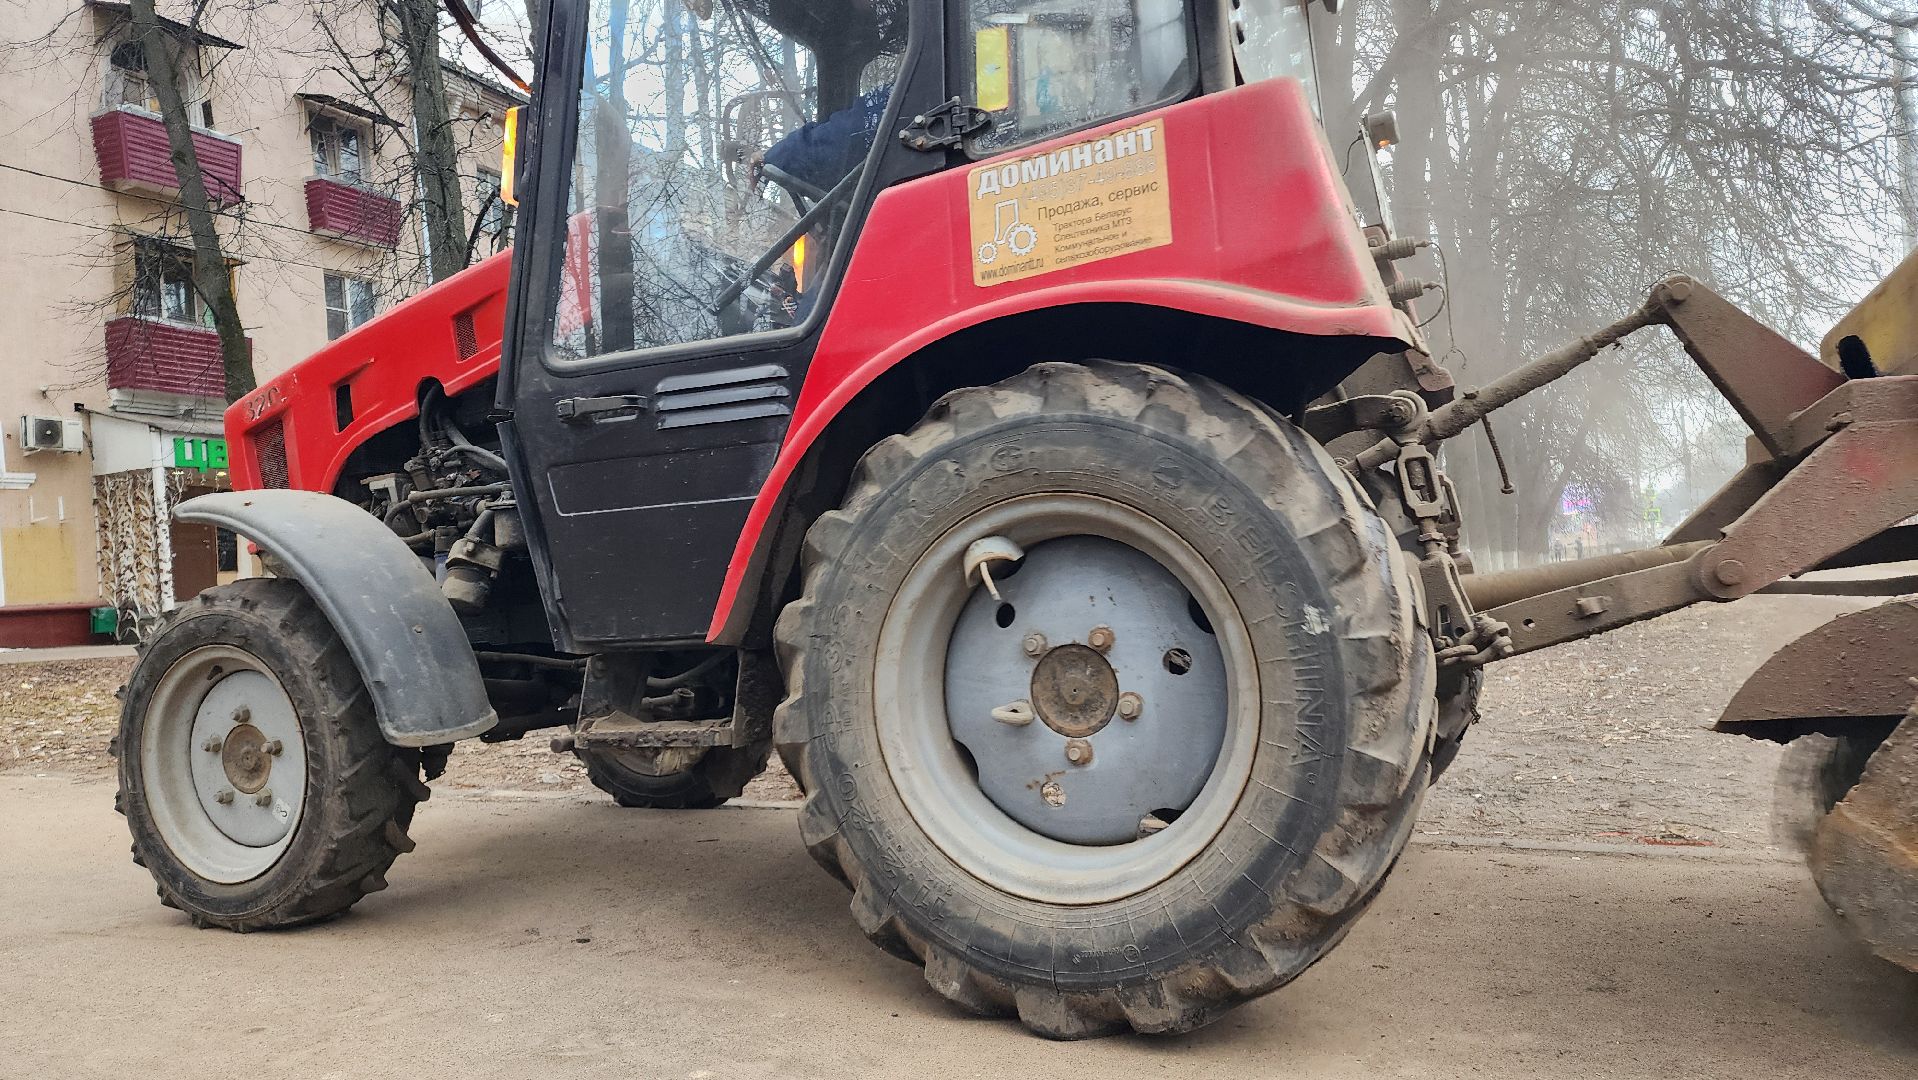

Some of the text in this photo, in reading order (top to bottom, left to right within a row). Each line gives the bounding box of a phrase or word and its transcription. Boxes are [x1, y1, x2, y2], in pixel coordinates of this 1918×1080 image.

[1038, 181, 1158, 220] Продажа, сервис
[1052, 207, 1132, 232] Трактора Беларус
[1053, 216, 1132, 242] Спецтехника МТЗ
[1054, 232, 1120, 252] Коммунальное
